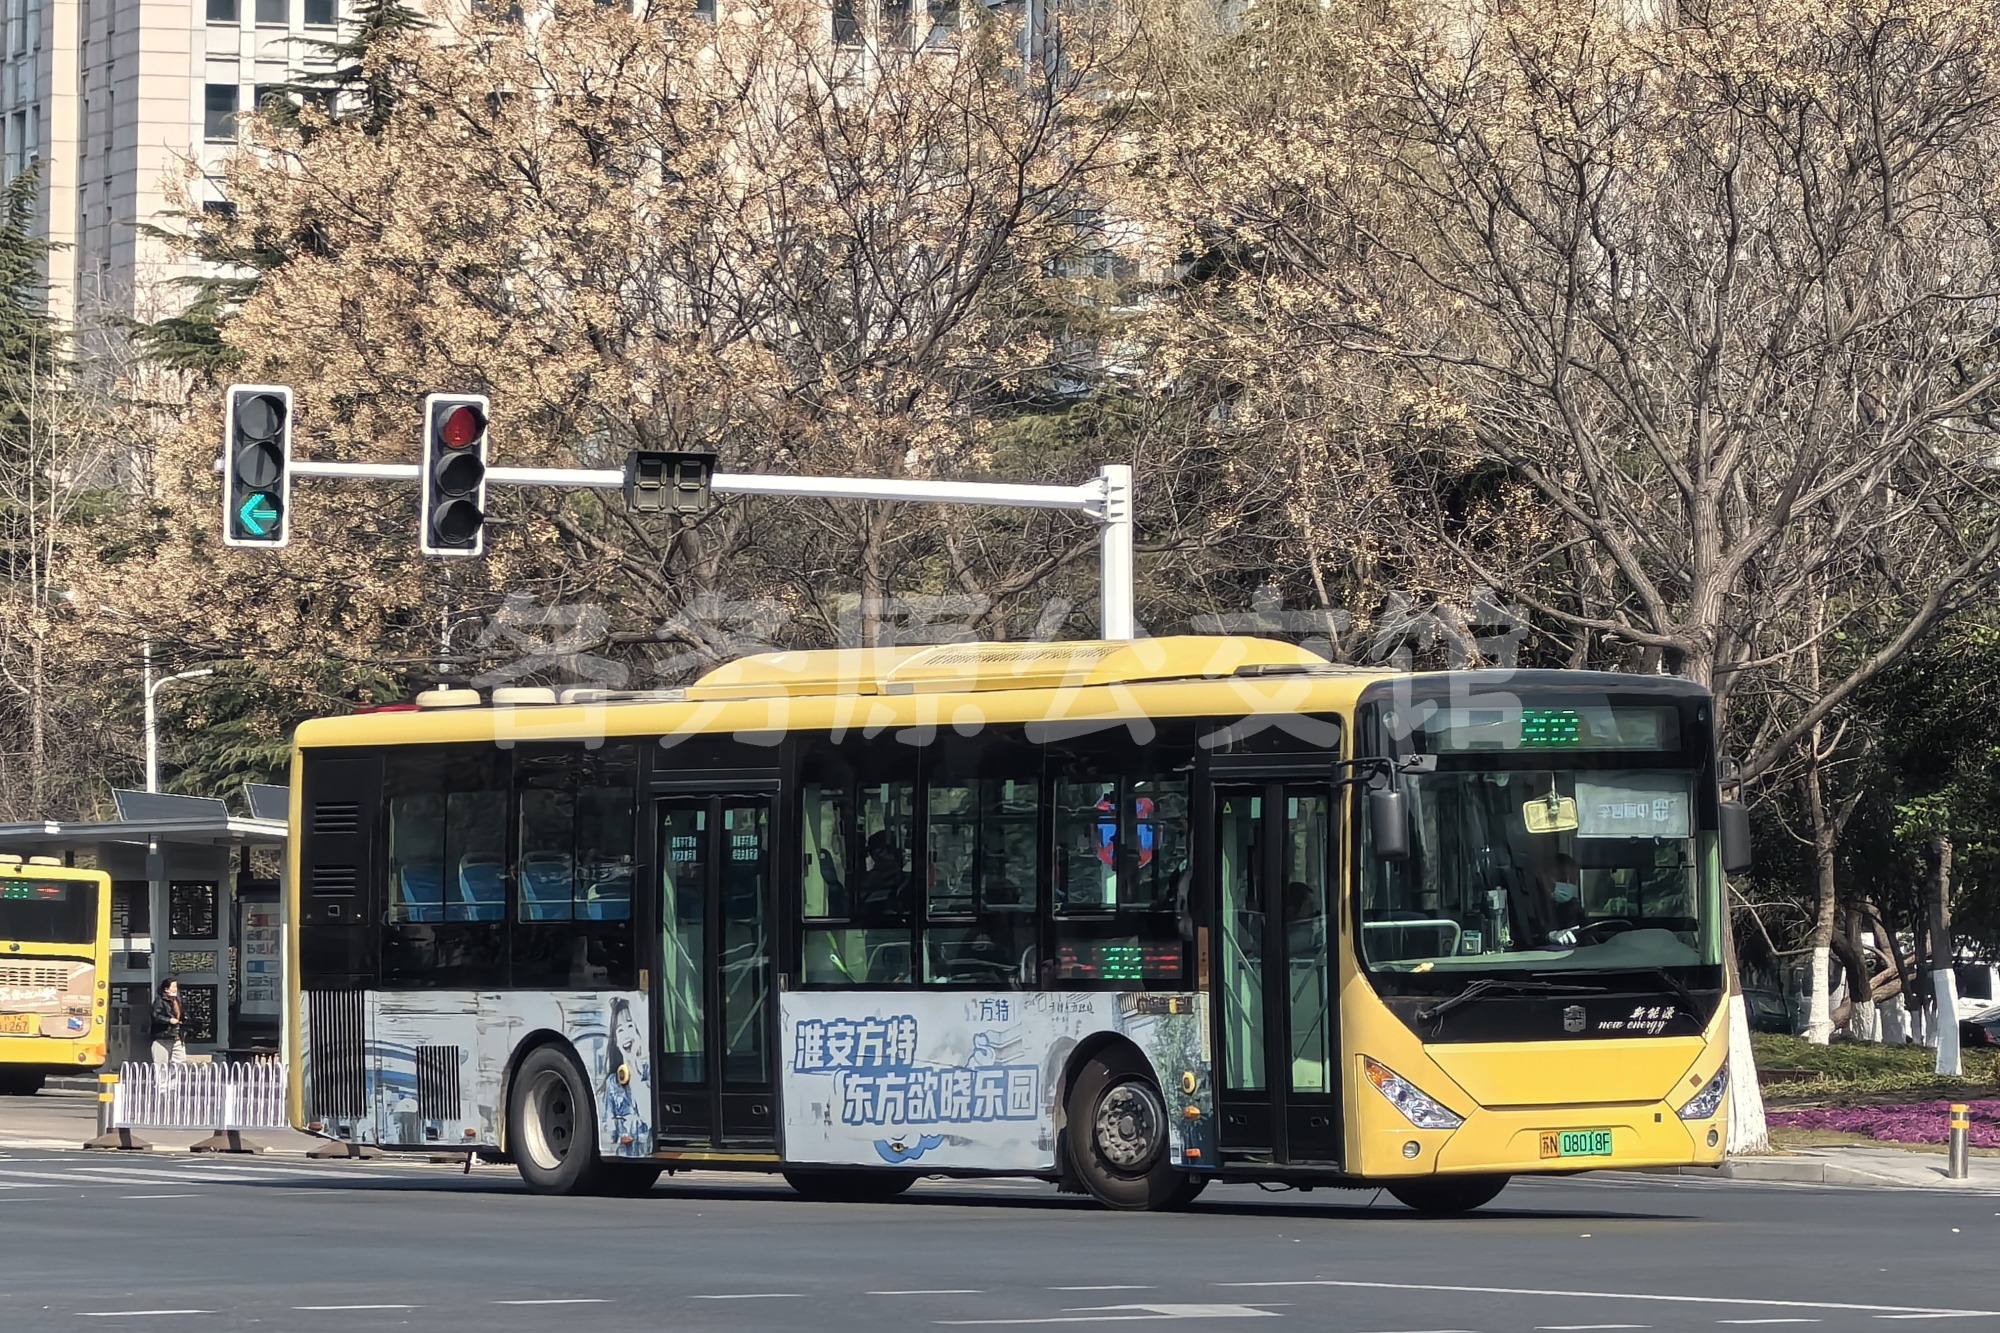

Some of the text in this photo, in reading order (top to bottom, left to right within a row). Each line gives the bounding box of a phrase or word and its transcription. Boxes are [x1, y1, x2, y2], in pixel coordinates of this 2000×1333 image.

[979, 999, 1009, 1022] 方特
[1629, 1006, 1675, 1021] 新能源
[1598, 1021, 1667, 1034] new energy
[797, 1018, 916, 1070] 淮安方特
[843, 1070, 1038, 1122] 东方欲晓乐园
